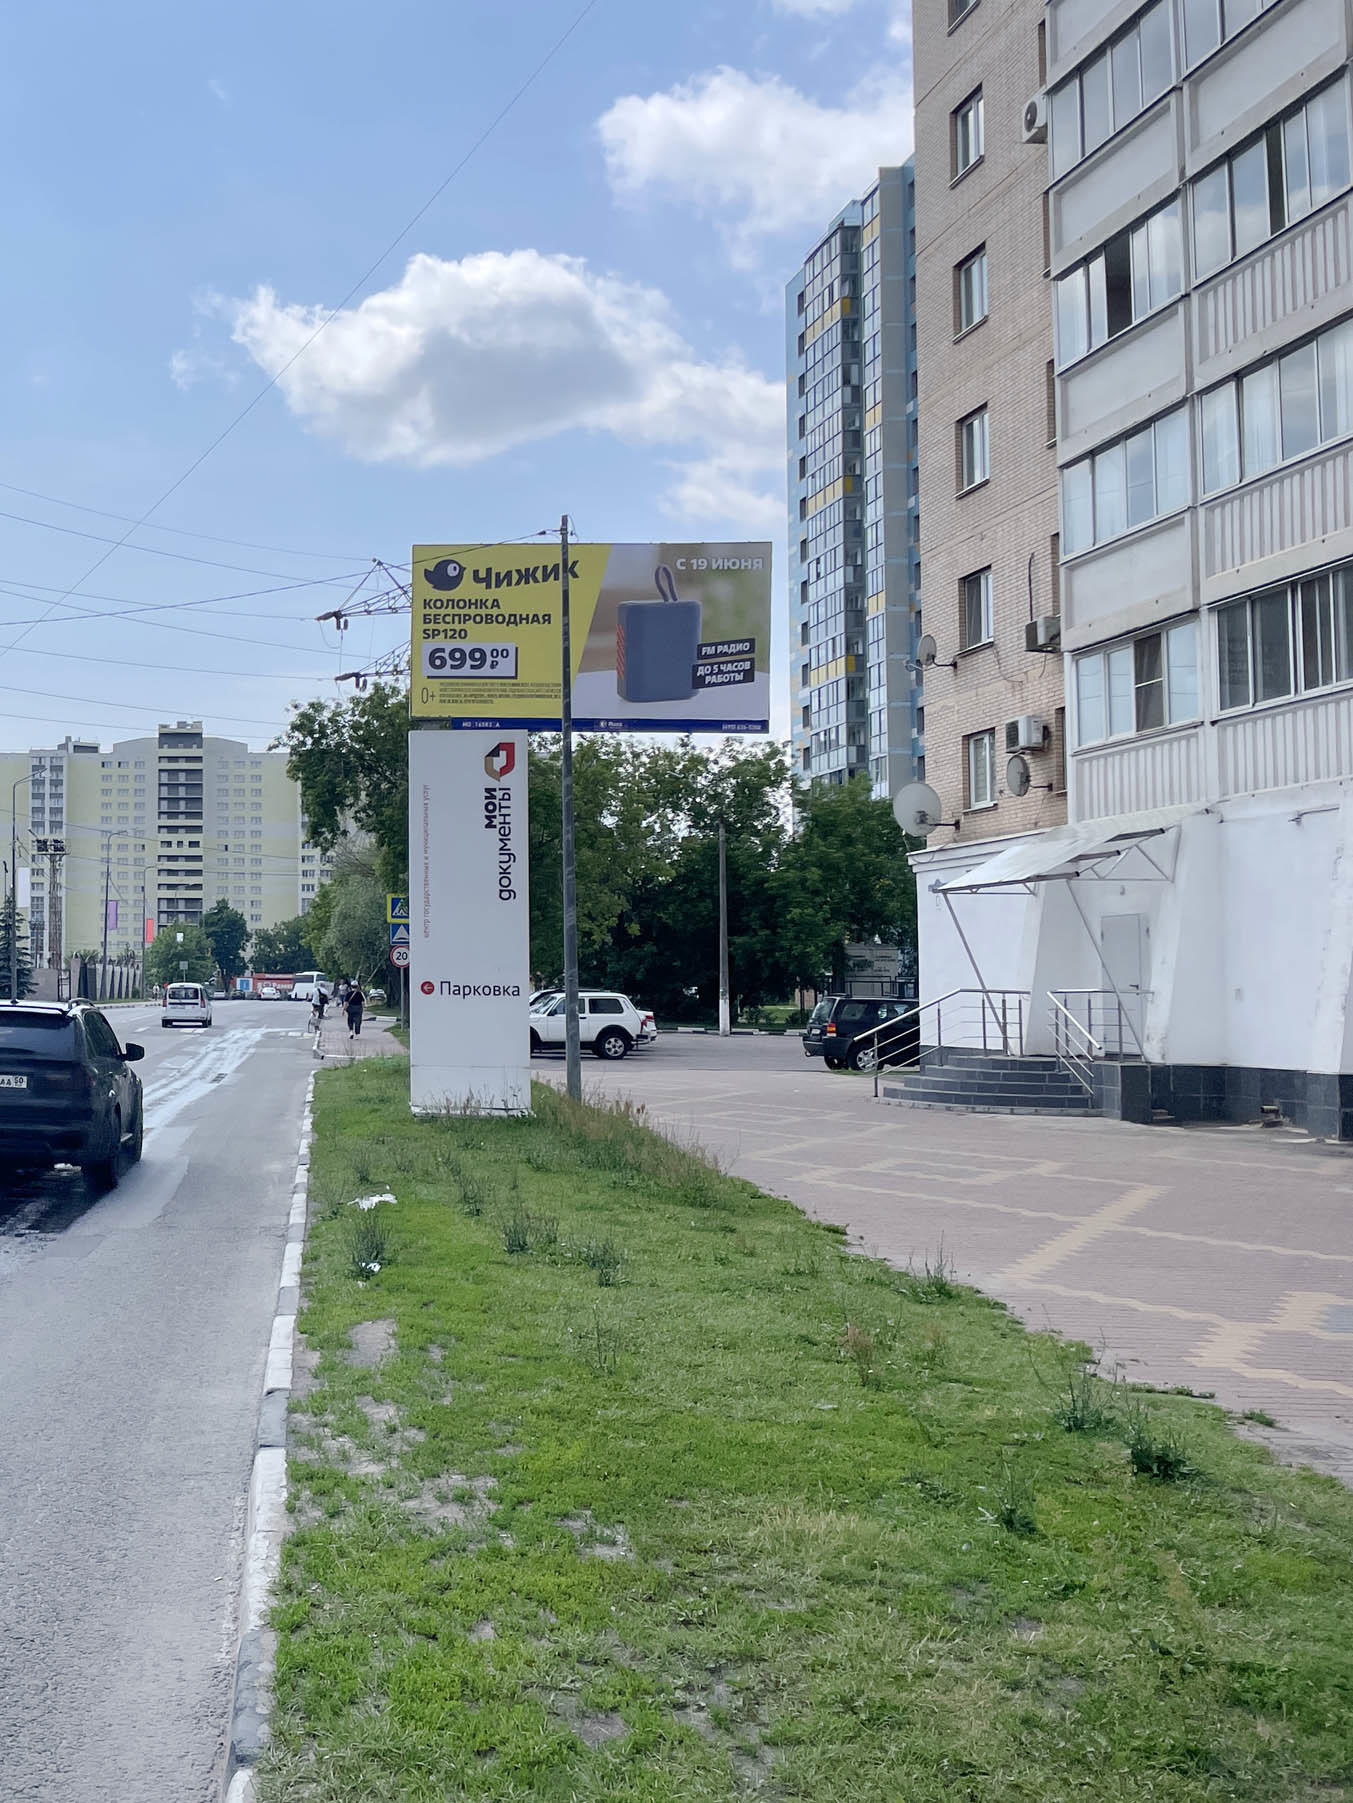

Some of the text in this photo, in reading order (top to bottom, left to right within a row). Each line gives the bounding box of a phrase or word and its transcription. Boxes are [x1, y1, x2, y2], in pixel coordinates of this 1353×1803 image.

[676, 558, 763, 570] С 19 ИЮНЯ
[423, 598, 501, 610] КОЛОНКА
[422, 613, 552, 627] БЕСПРОВОДНАЯ
[422, 628, 468, 640] SP120
[701, 642, 750, 656] FM РАДИО
[428, 647, 487, 670] 699
[696, 661, 751, 676] ДО 5 ЧАСОВ
[704, 671, 744, 684] РАБОТЫ
[421, 687, 436, 704] 0+
[484, 787, 497, 829] мои
[498, 787, 517, 901] документы
[396, 951, 408, 961] 20
[439, 980, 521, 999] Парковка
